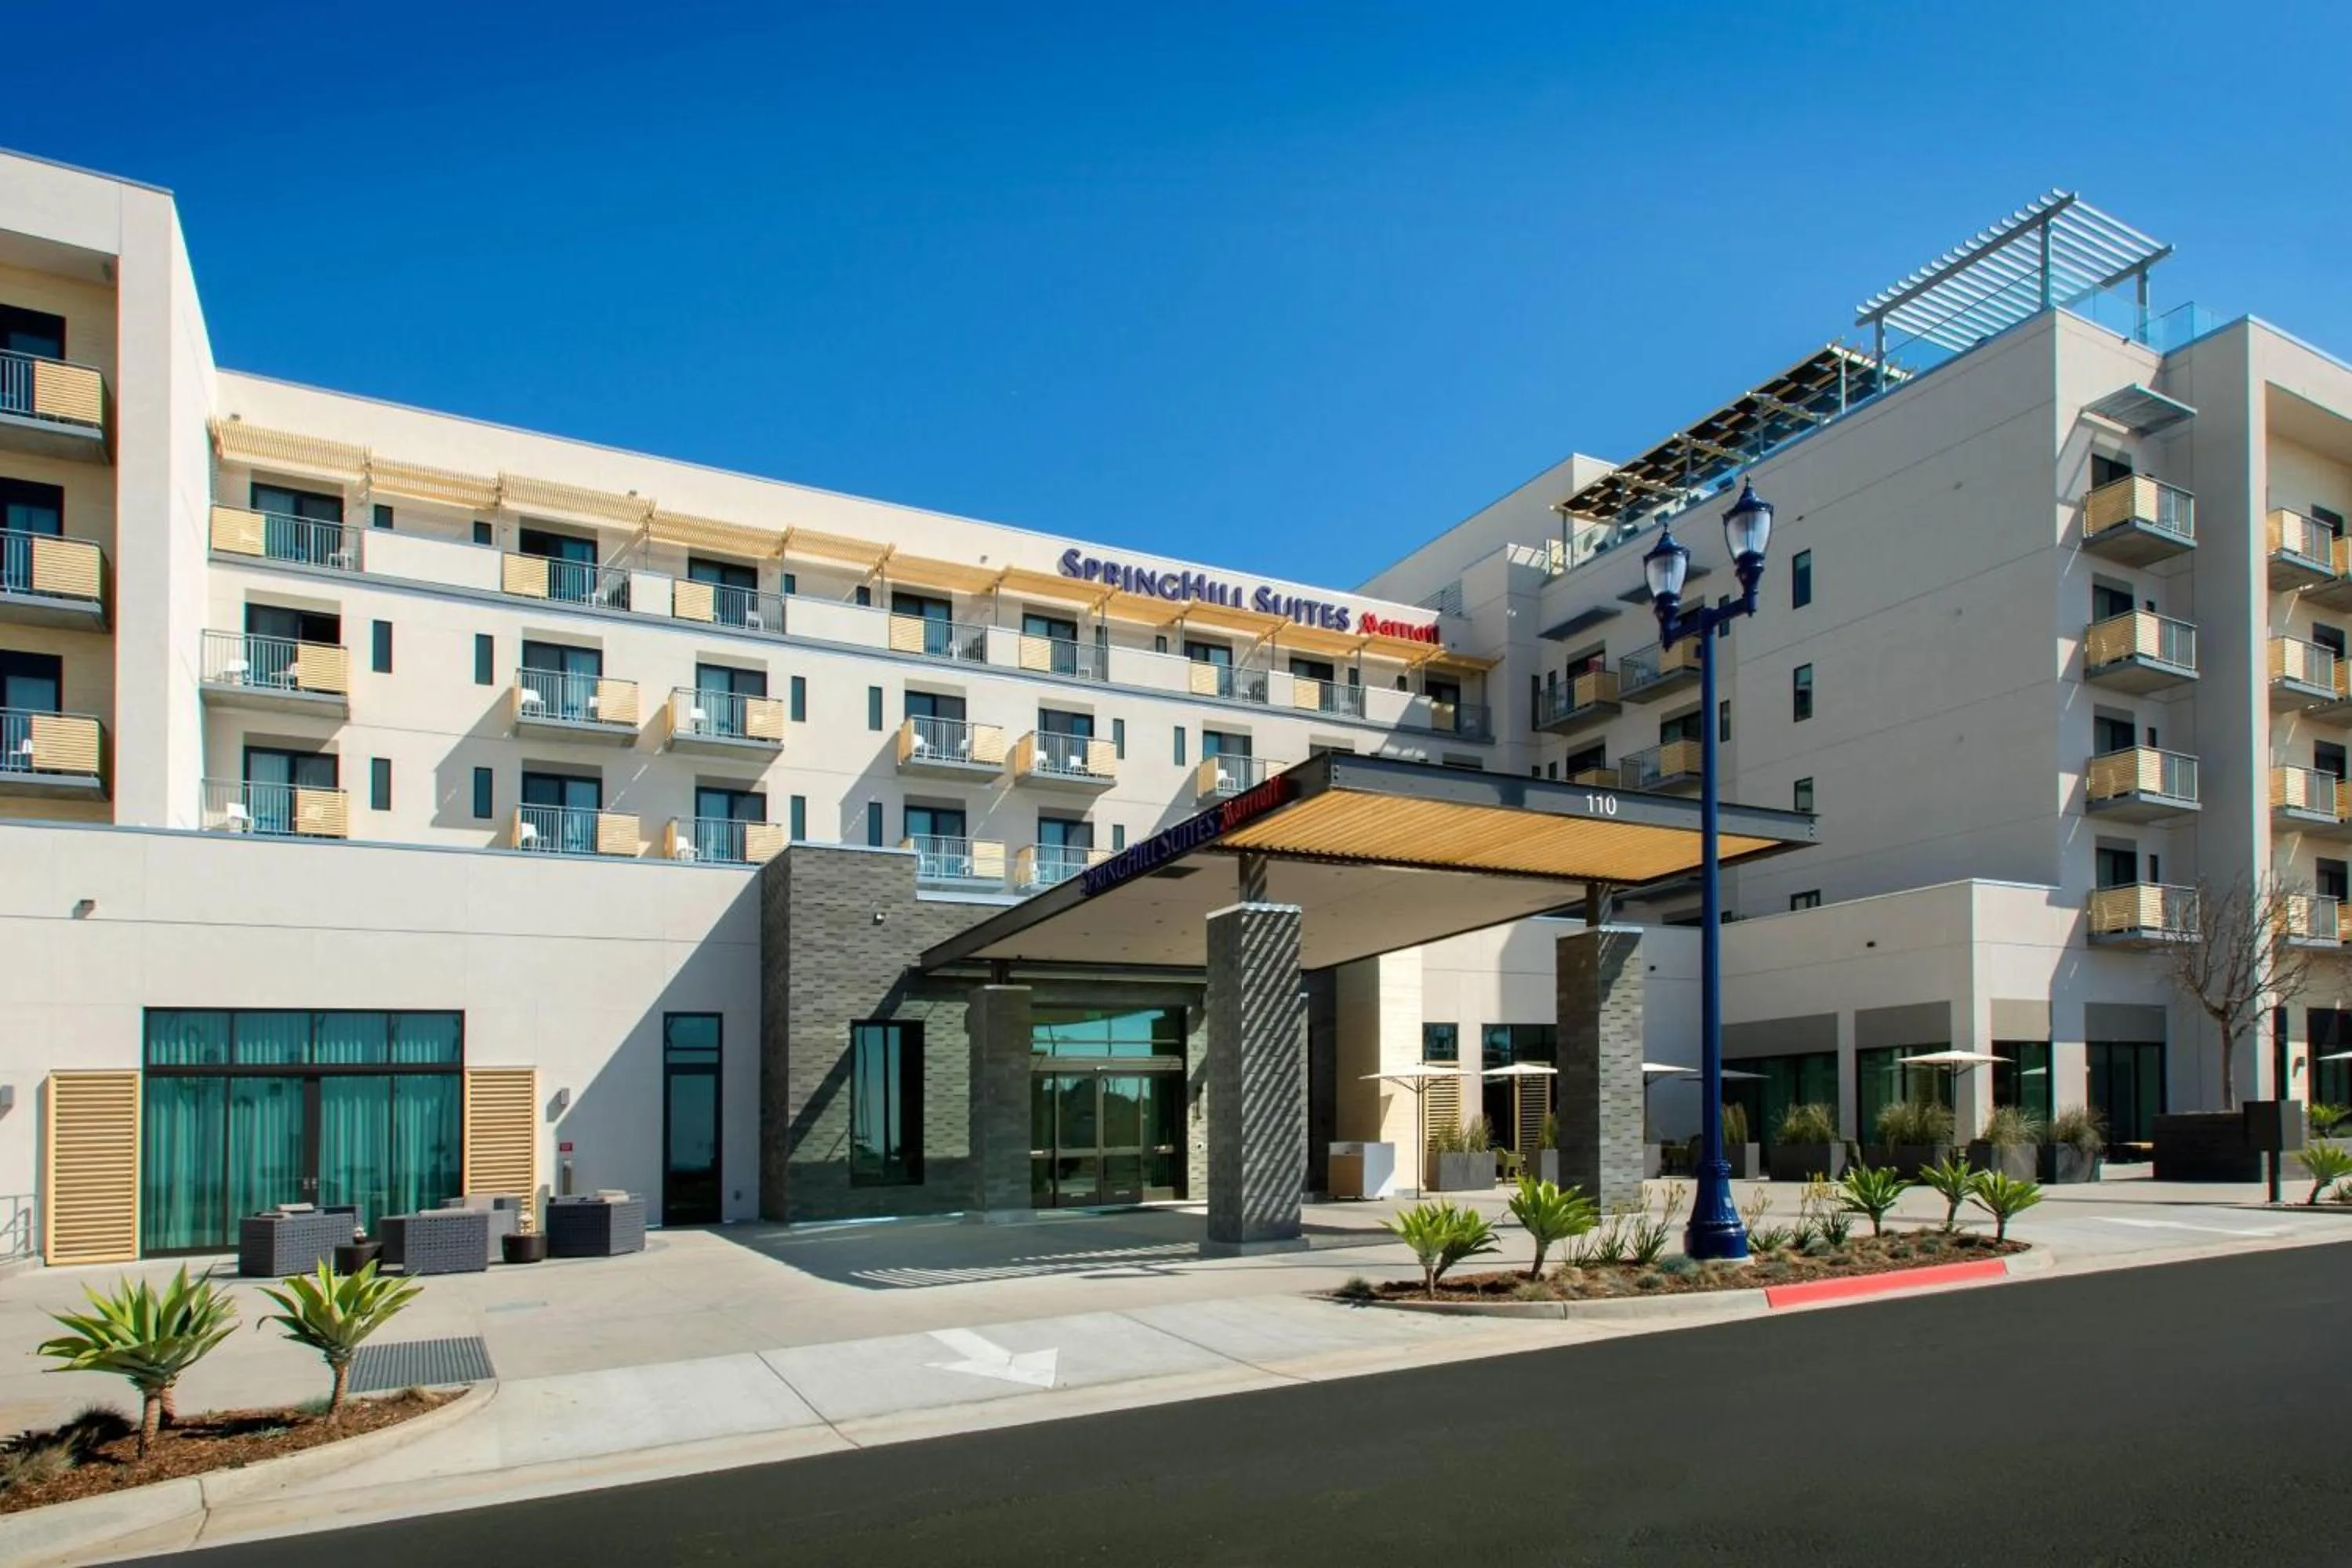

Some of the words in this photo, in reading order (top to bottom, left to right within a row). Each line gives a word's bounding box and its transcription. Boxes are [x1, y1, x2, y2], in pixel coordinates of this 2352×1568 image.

[1254, 586, 1350, 631] SUITES
[1586, 793, 1617, 815] 110
[1160, 809, 1216, 859] SUITES
